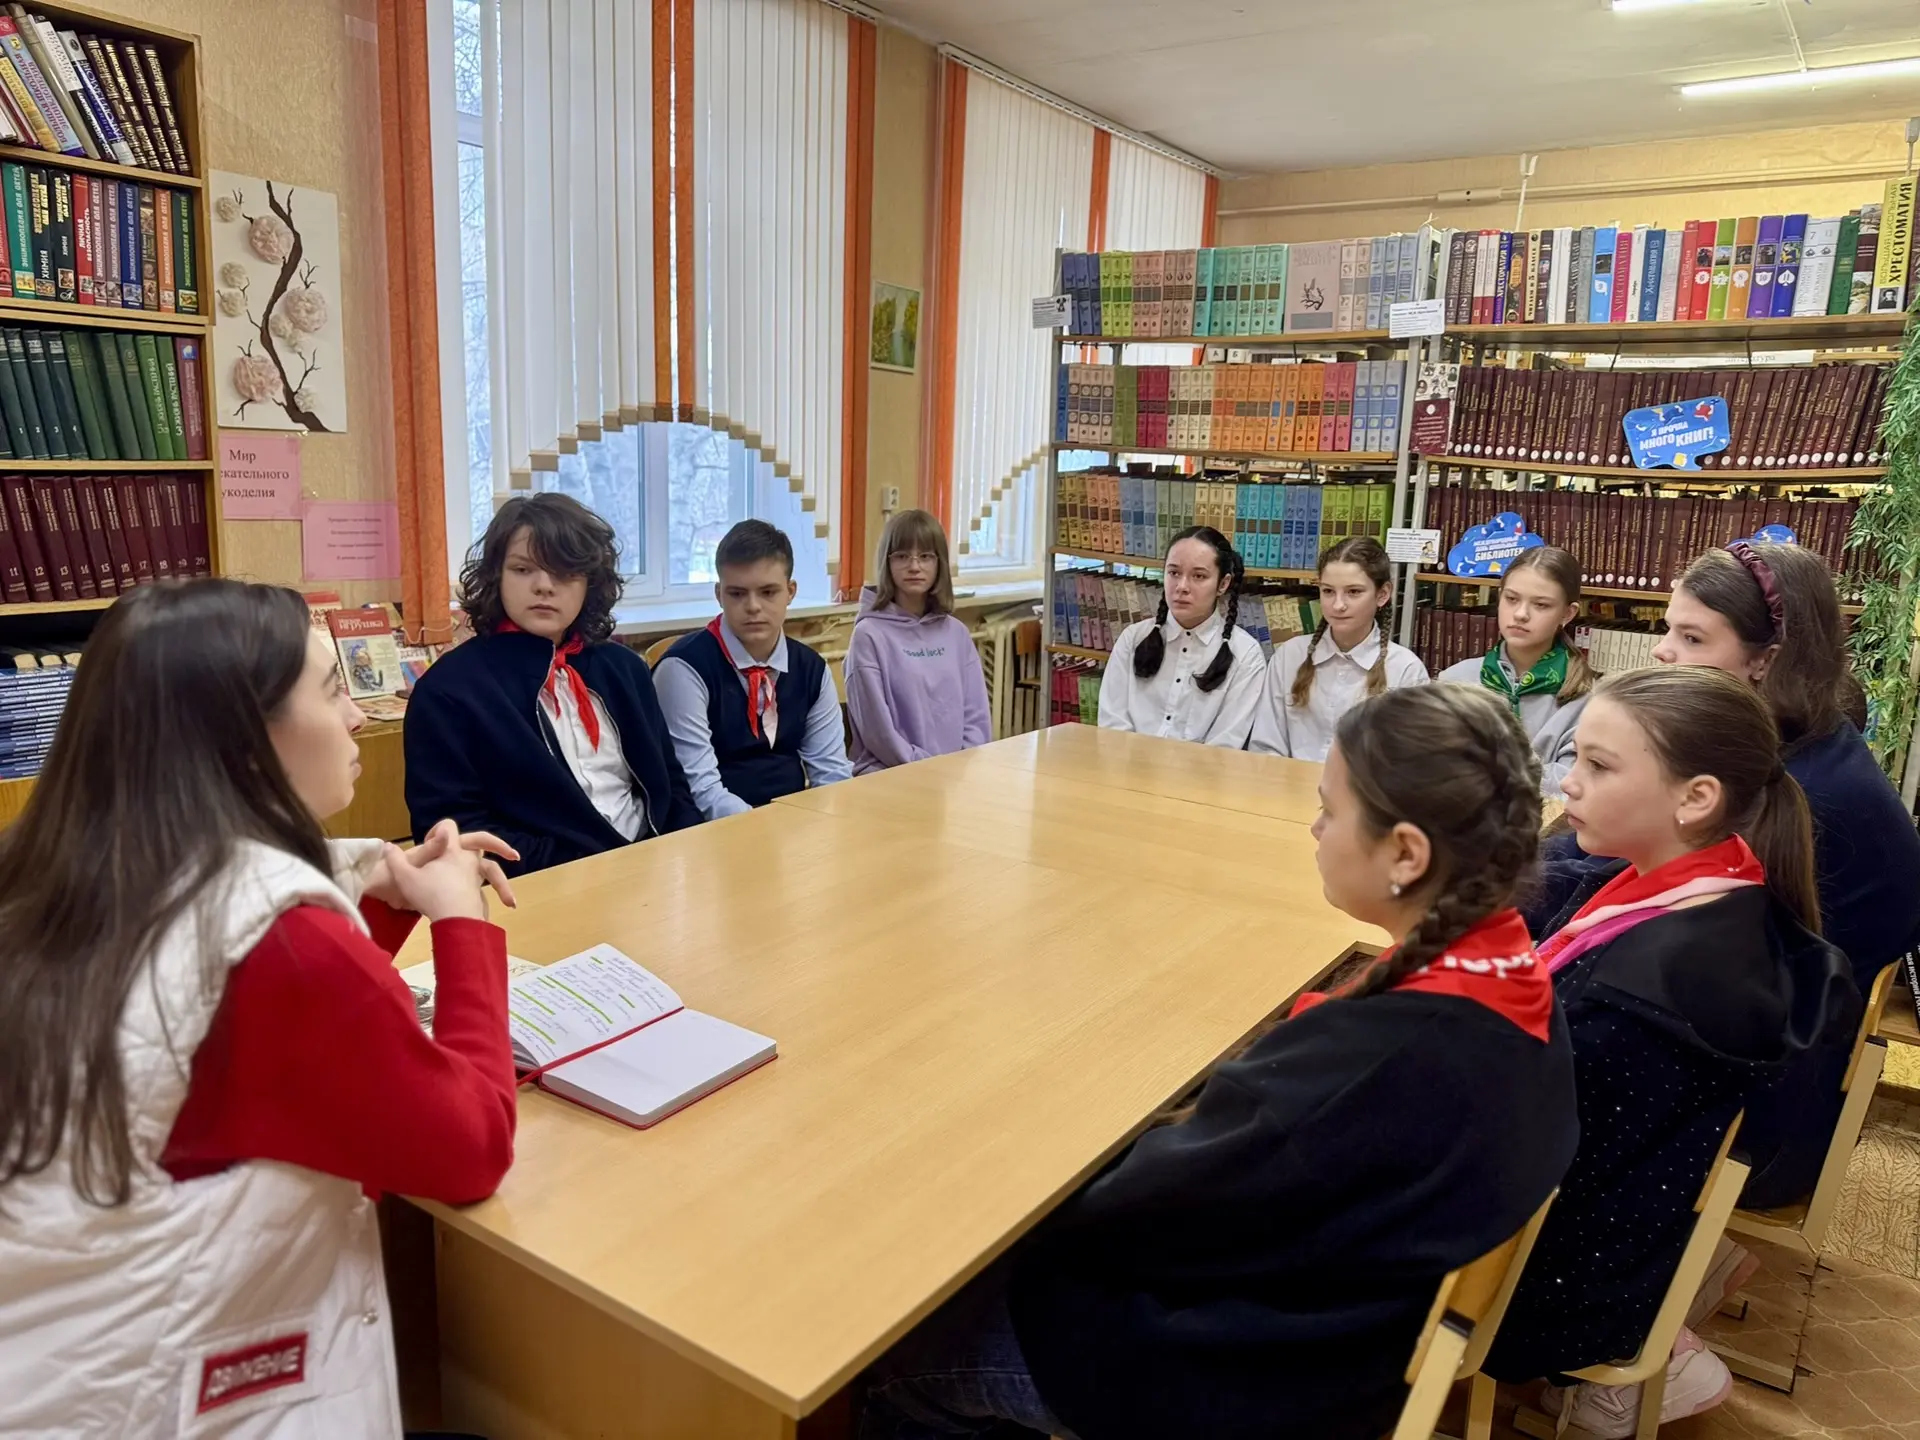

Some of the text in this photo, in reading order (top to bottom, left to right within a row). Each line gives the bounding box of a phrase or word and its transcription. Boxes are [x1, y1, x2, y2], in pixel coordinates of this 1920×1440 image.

[15, 54, 67, 143] БОЛЬШАЯ ШКОЛЬНАЯ
[28, 62, 68, 130] ЭНЦИКЛОПЕДИЯ
[12, 167, 22, 190] ДЕТЕЙ
[91, 182, 99, 203] ДЕТЕЙ
[160, 194, 168, 214] ДЕТЕЙ
[18, 210, 28, 267] ЭНЦИКЛОПЕДИЯ
[84, 208, 92, 261] БЕЗОПАСНОСТЬ
[1810, 232, 1816, 240] 7
[1880, 184, 1898, 284] БОЛЬШАЯ ШКОЛЬНАЯ
[1889, 182, 1912, 283] ХРЕСТОМАТИЯ
[94, 222, 103, 277] ЭНЦИКЛОПЕДИЯ
[110, 224, 118, 278] ЭНЦИКЛОПЕДИЯ
[128, 227, 136, 280] ЭНЦИКЛОПЕДИЯ
[40, 250, 49, 278] ХИМИЯ
[1497, 249, 1507, 297] ХРЕСТОМАТИЯ
[1615, 240, 1629, 311] ХРЕСТОМАТИЯ
[1640, 426, 1714, 450] МНОГО КНИГ!
[229, 449, 256, 464] Мир
[9, 567, 19, 576] 11
[34, 566, 44, 576] 12
[60, 566, 68, 575] 13
[101, 563, 110, 573] 15
[160, 560, 168, 570] 18
